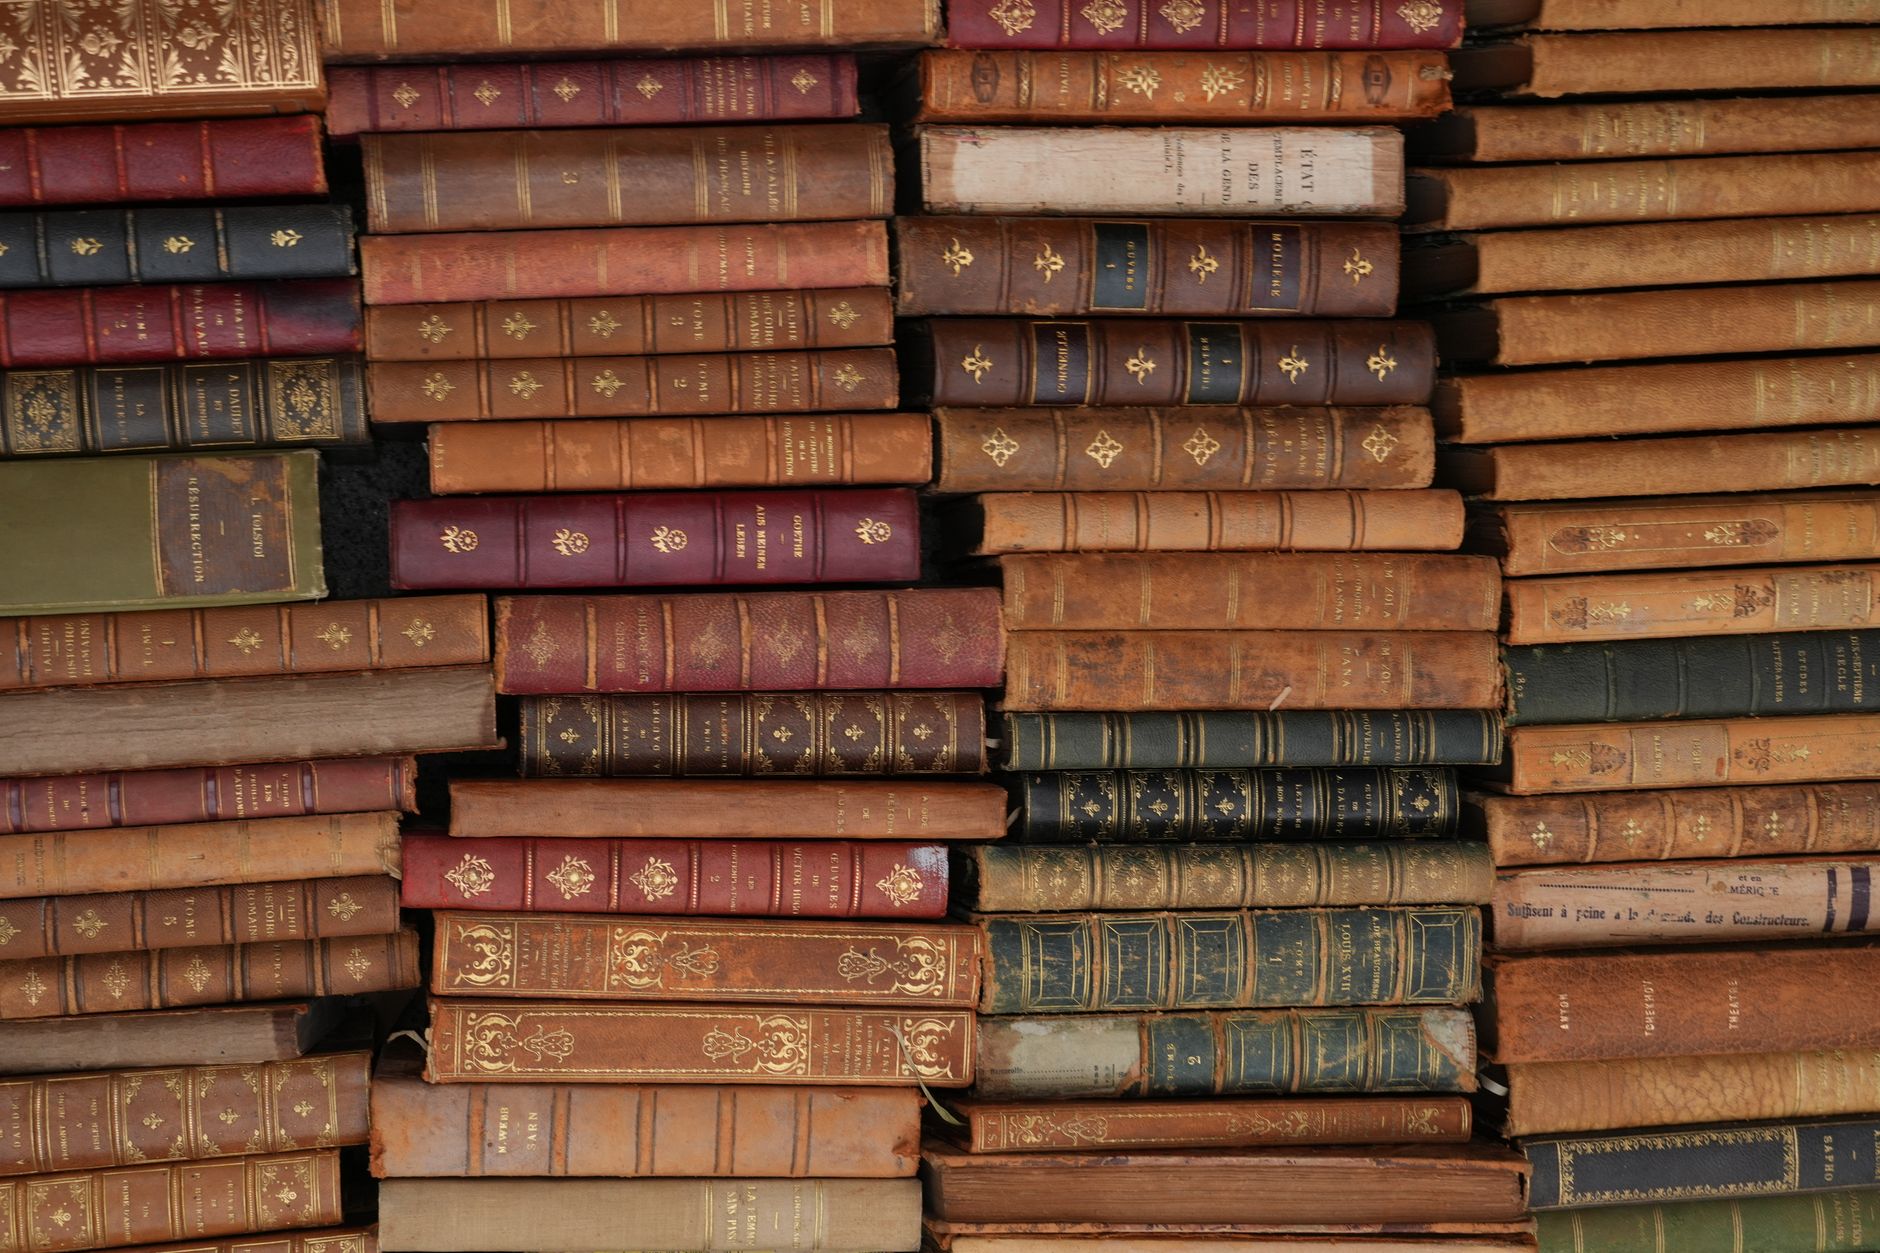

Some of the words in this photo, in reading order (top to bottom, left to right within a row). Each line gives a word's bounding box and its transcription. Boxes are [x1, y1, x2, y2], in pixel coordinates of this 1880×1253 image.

[1221, 149, 1232, 163] LA
[1301, 149, 1317, 192] ÉTAT
[1248, 162, 1261, 190] DES
[135, 305, 148, 341] TOME
[192, 289, 209, 356] MARIVAUX
[671, 316, 685, 326] 3
[693, 301, 704, 341] TOME
[674, 377, 688, 388] 2
[697, 362, 709, 402] TOME
[230, 389, 244, 438] DAUDET
[809, 435, 818, 475] CHAPITRE
[755, 504, 767, 526] AUS
[735, 523, 746, 559] LEBEN
[792, 515, 804, 559] GOETHE
[1383, 586, 1395, 619] ZOLA
[80, 617, 93, 677] ROMAINE
[141, 623, 155, 666] TOME
[637, 608, 649, 652] RACINE
[66, 621, 78, 679] HISTOIRE
[1342, 646, 1352, 688] NANA
[652, 699, 661, 752] DAUDET
[704, 720, 712, 752] NUMA
[1393, 721, 1402, 763] SANDEAU
[250, 773, 259, 812] FEUILLES
[264, 784, 273, 802] LES
[281, 784, 291, 808] HUGO
[1295, 783, 1304, 829] LETTRES
[1336, 787, 1346, 834] DAUDET
[862, 807, 870, 821] DE
[921, 807, 930, 830] GIDE
[709, 874, 721, 884] 2
[747, 875, 756, 891] LES
[792, 846, 803, 886] VICTOR
[812, 874, 820, 888] DE
[829, 852, 840, 910] ŒUVRES
[1739, 874, 1749, 882] et
[1751, 875, 1762, 883] en
[792, 888, 802, 916] HUGO
[1728, 884, 1780, 897] MÉRIQE
[164, 915, 178, 926] 5
[185, 896, 197, 939] TOME
[264, 884, 276, 938] HISTOIRE
[1705, 911, 1724, 925] des
[1295, 940, 1303, 977] TOME
[1341, 923, 1352, 961] LOUIS
[1341, 965, 1352, 992] XVII
[1370, 940, 1381, 1000] BEAUCHESNE
[1559, 993, 1570, 1030] ANTON
[831, 1043, 841, 1054] VI
[883, 1037, 892, 1074] TAINE
[1166, 1043, 1175, 1081] TOME
[1186, 1055, 1201, 1066] 2
[526, 1111, 538, 1152] SARN
[1823, 1134, 1836, 1183] SAPHO
[122, 1179, 132, 1206] CRIME
[726, 1191, 738, 1215] SANS
[747, 1185, 758, 1202] LA
